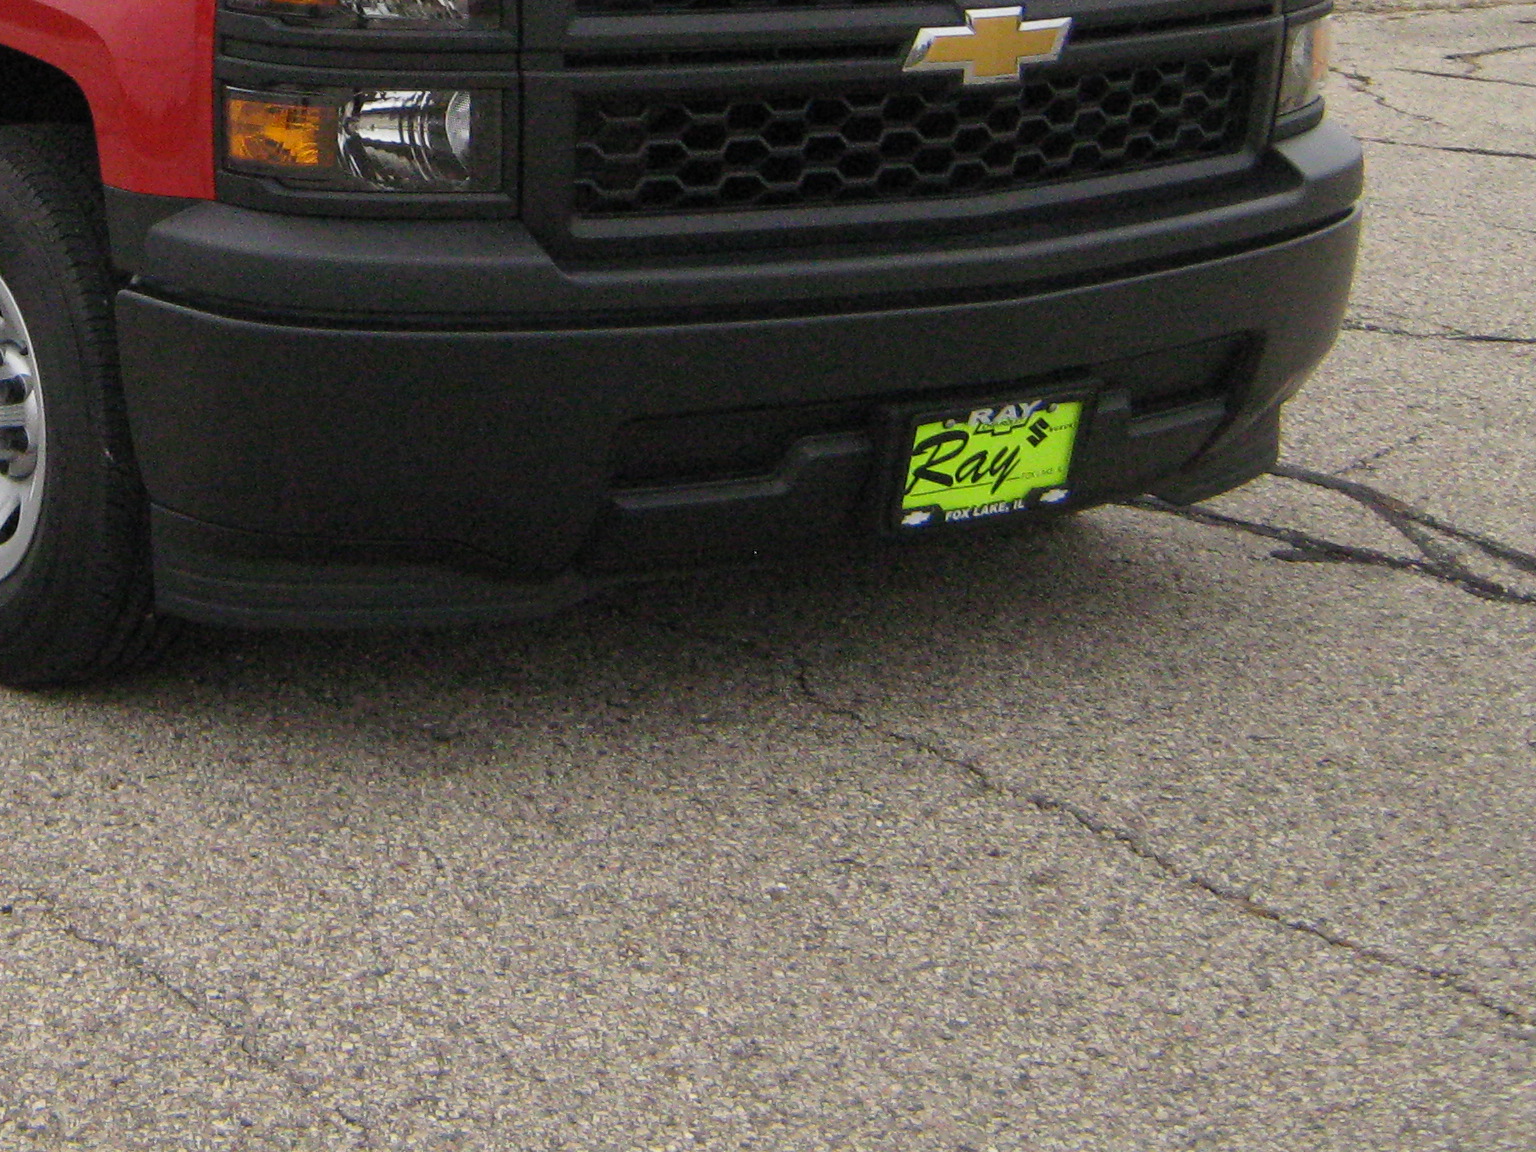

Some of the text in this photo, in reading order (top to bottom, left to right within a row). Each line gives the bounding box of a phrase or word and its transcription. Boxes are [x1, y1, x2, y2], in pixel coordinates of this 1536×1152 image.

[967, 399, 1046, 426] RAY
[904, 430, 1021, 495] Ray
[945, 508, 971, 523] FOX
[1013, 498, 1026, 511] IL
